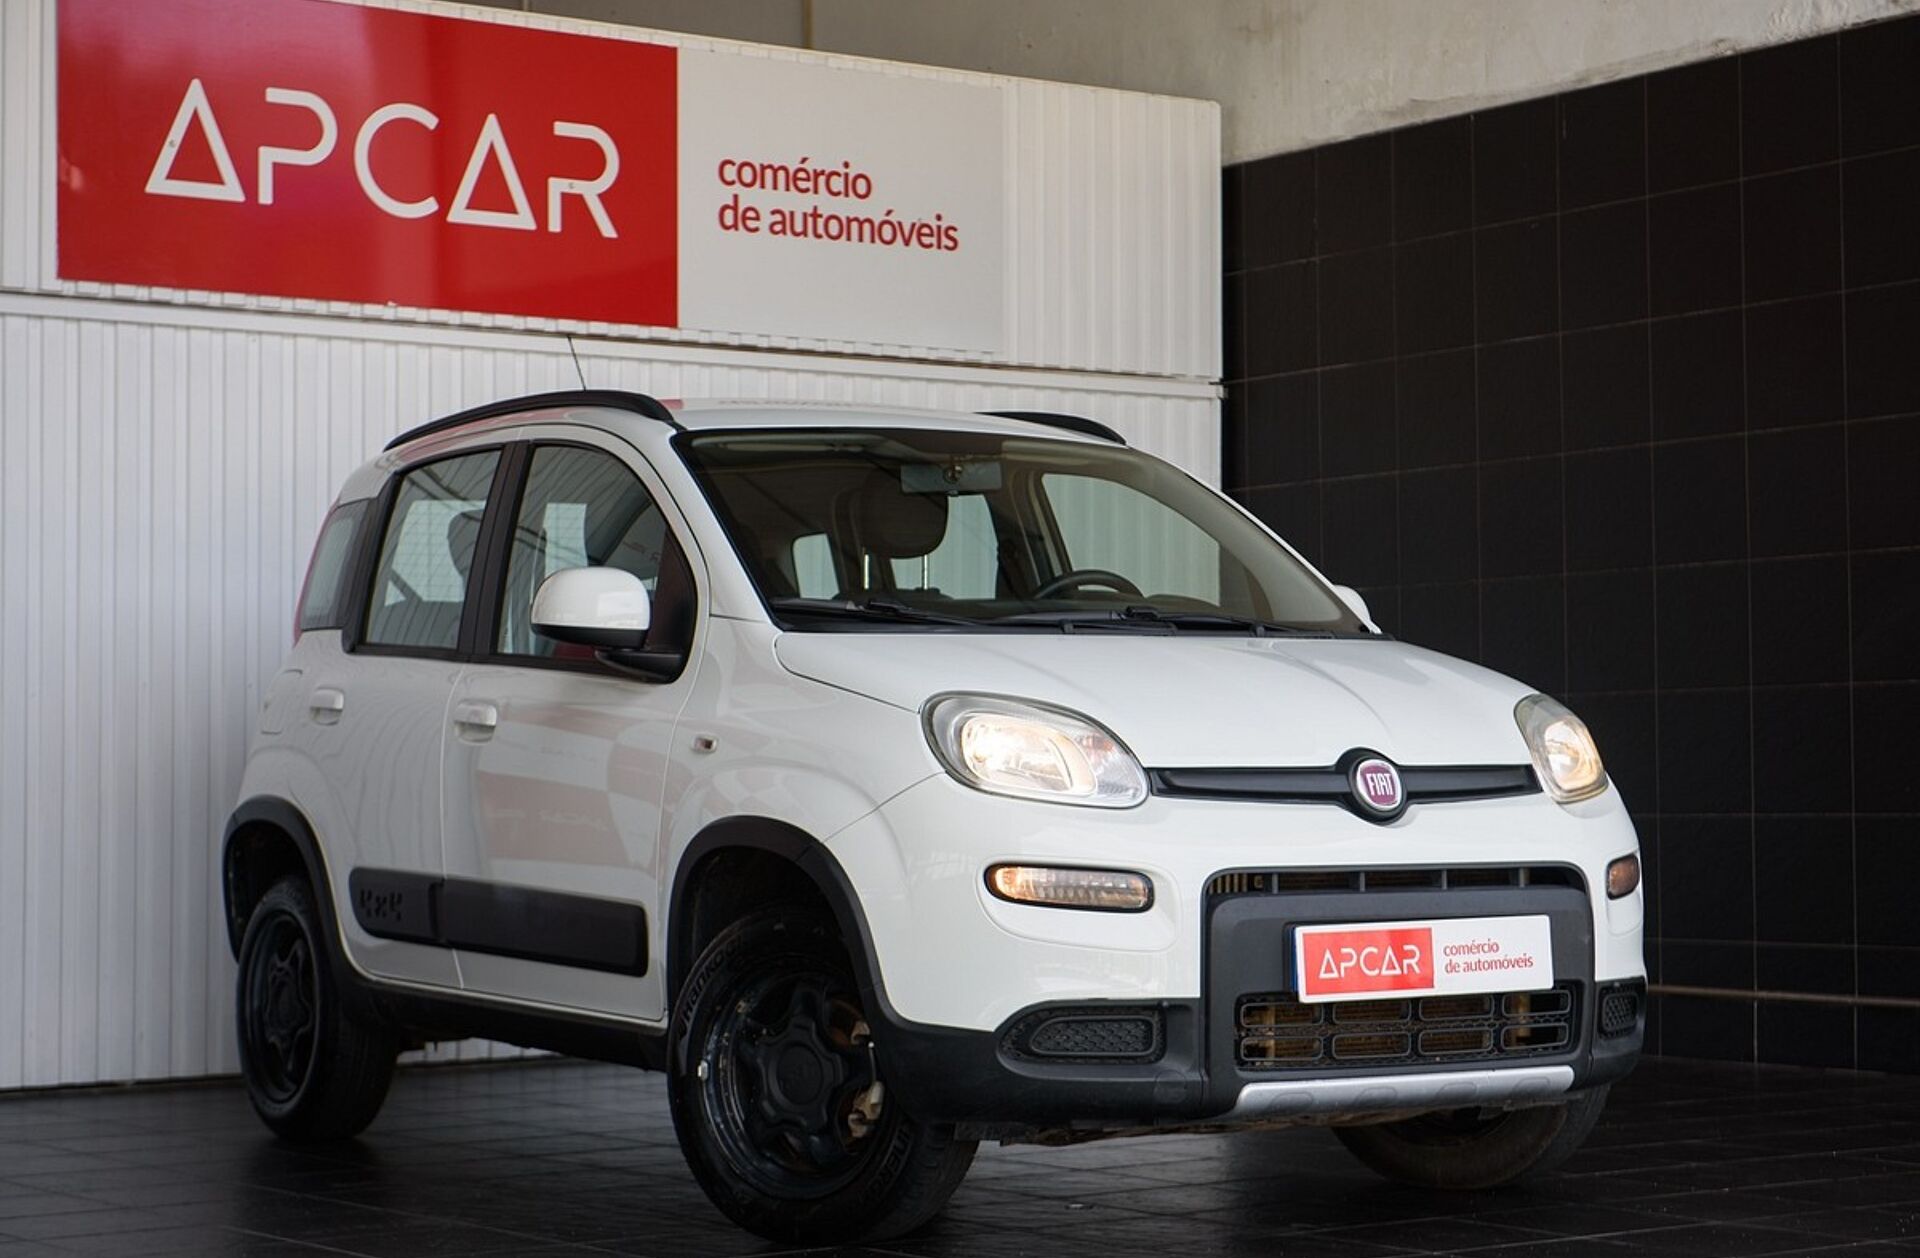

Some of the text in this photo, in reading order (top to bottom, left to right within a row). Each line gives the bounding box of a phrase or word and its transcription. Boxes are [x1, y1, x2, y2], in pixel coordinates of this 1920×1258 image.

[145, 78, 620, 238] APCAR
[718, 157, 872, 199] comércio
[718, 193, 959, 252] de automóveis
[1366, 772, 1395, 796] FIAT
[1319, 944, 1421, 979] APCAR
[1443, 938, 1499, 956] comércio
[1445, 953, 1533, 974] de automóveis
